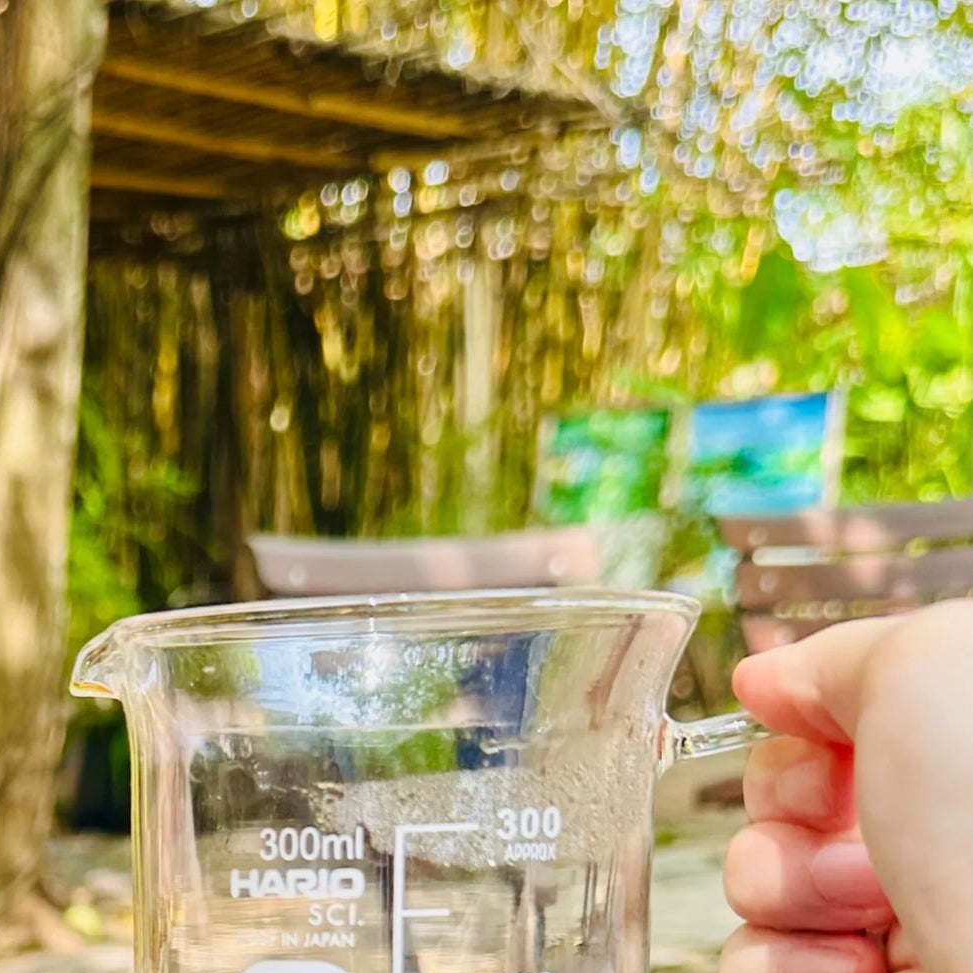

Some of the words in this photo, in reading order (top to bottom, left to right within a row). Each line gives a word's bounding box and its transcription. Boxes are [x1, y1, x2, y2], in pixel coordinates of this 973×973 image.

[497, 806, 561, 840] 300
[259, 825, 364, 861] 300ml
[230, 867, 365, 899] HARIO
[308, 903, 364, 926] SCI.
[281, 932, 299, 947] IN
[303, 932, 356, 948] JAPAN
